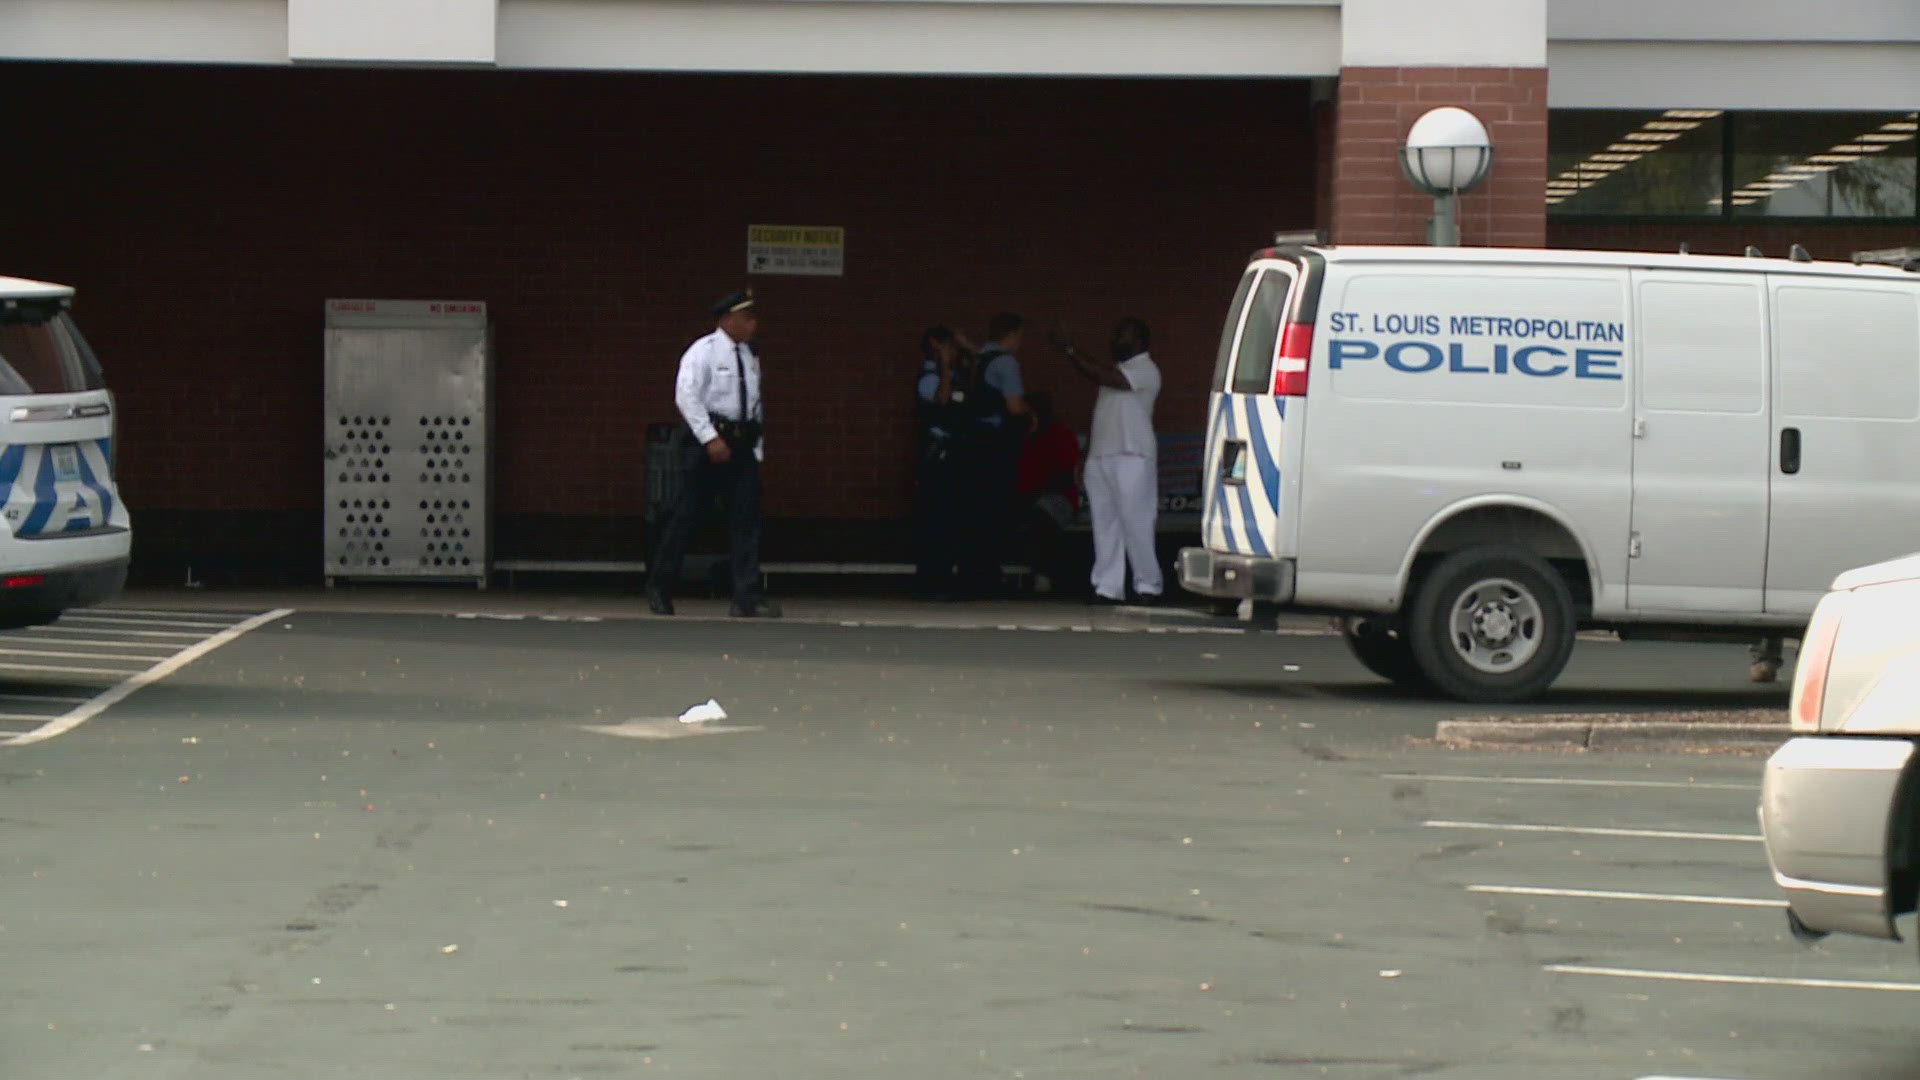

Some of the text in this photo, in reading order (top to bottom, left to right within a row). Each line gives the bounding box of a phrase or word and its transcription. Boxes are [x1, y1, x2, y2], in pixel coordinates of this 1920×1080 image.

[751, 228, 840, 244] SECURITY NOTICE
[430, 304, 482, 314] NO SMOKING
[1330, 312, 1624, 342] ST. LOUIS METROPOLITAN
[1328, 339, 1624, 381] POLICE
